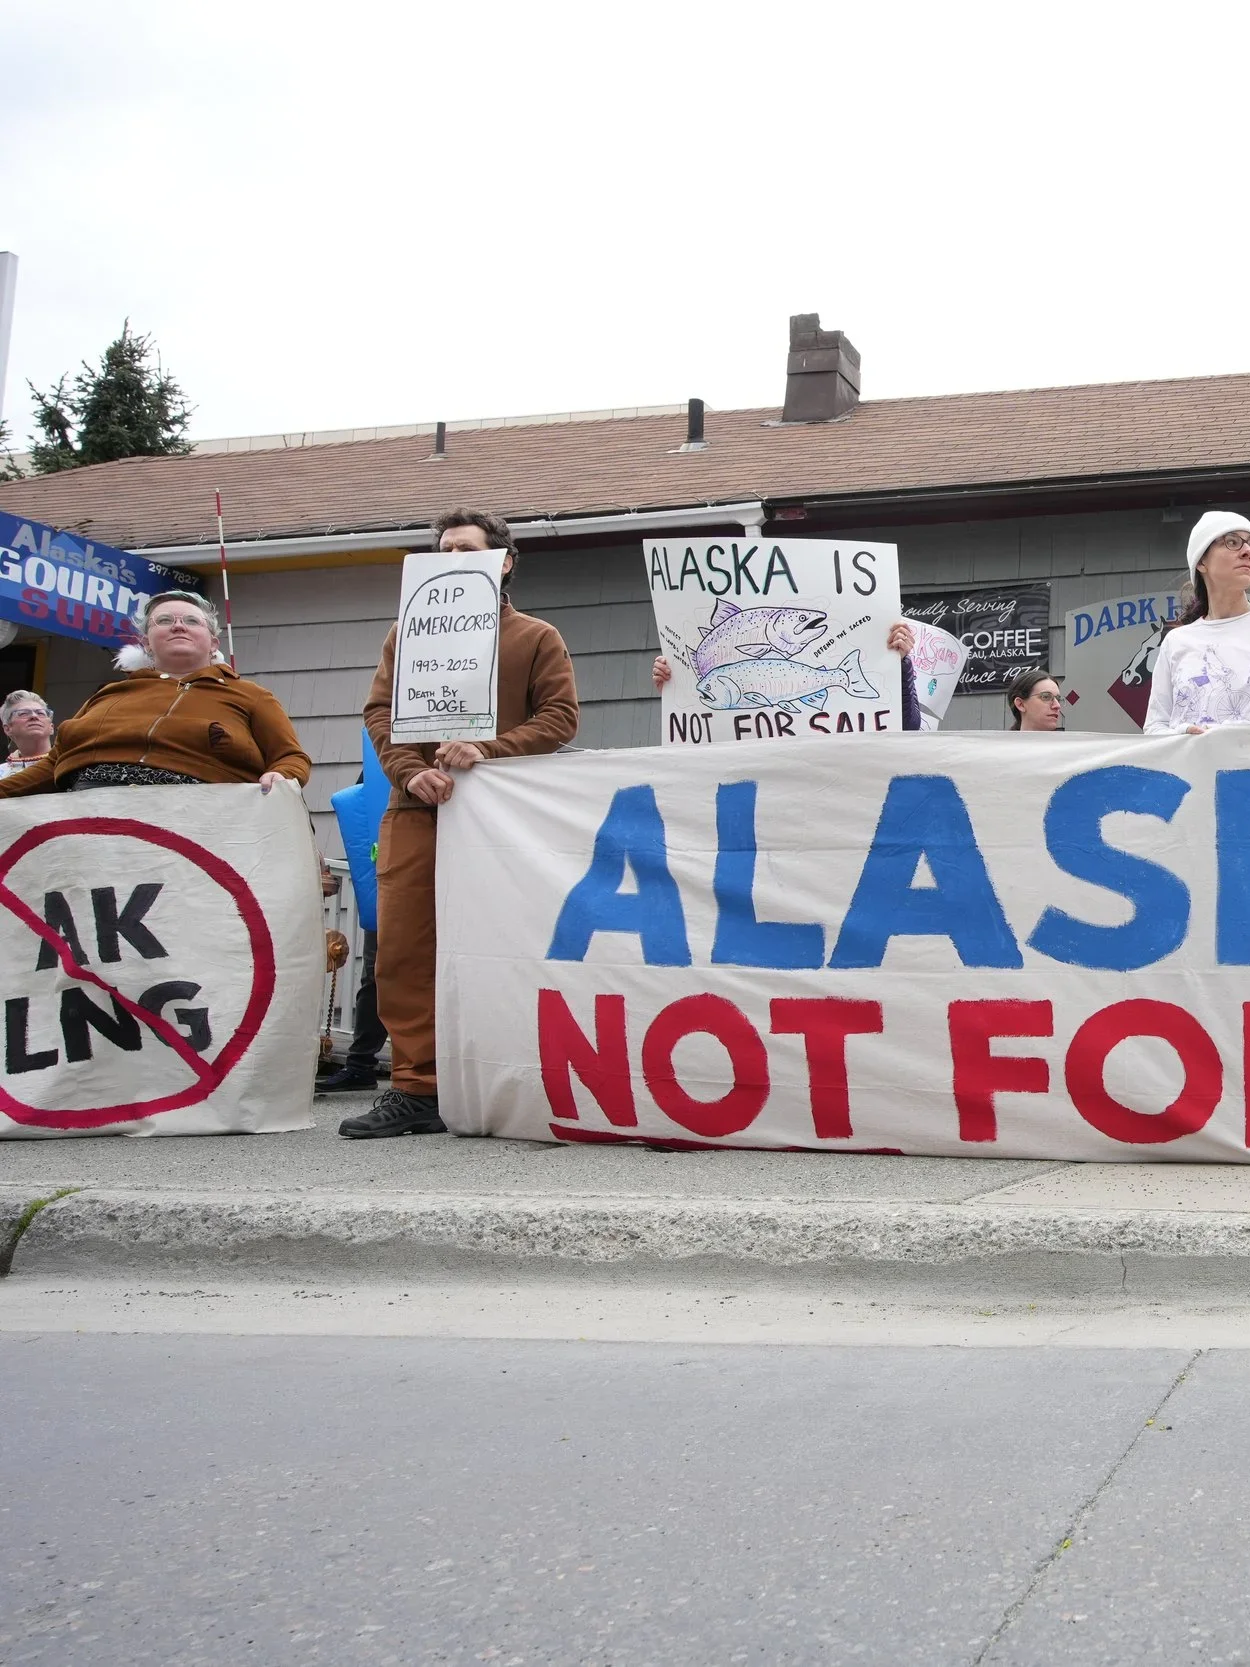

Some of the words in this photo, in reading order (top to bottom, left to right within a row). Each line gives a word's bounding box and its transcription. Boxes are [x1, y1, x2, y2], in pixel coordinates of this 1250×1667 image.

[11, 523, 137, 586] Alaska's
[651, 543, 798, 596] ALASKA
[833, 550, 876, 596] IS
[0, 546, 151, 618] GOURM
[427, 587, 465, 606] RIP
[407, 612, 497, 638] AMERICORPS
[952, 597, 1017, 623] Serving
[1074, 597, 1158, 647] DARK
[813, 638, 835, 658] DEFEND
[836, 630, 847, 640] THE
[849, 615, 871, 631] SACRED
[959, 628, 1042, 657] COFFEE
[990, 648, 1025, 658] ALASKA
[411, 658, 478, 673] 1993-2025
[959, 667, 997, 684] since
[427, 699, 470, 713] DOGE
[669, 711, 713, 744] NOT
[734, 711, 796, 741] FOR
[35, 882, 169, 972] AK
[5, 980, 213, 1075] LNG
[537, 988, 884, 1139] NOT
